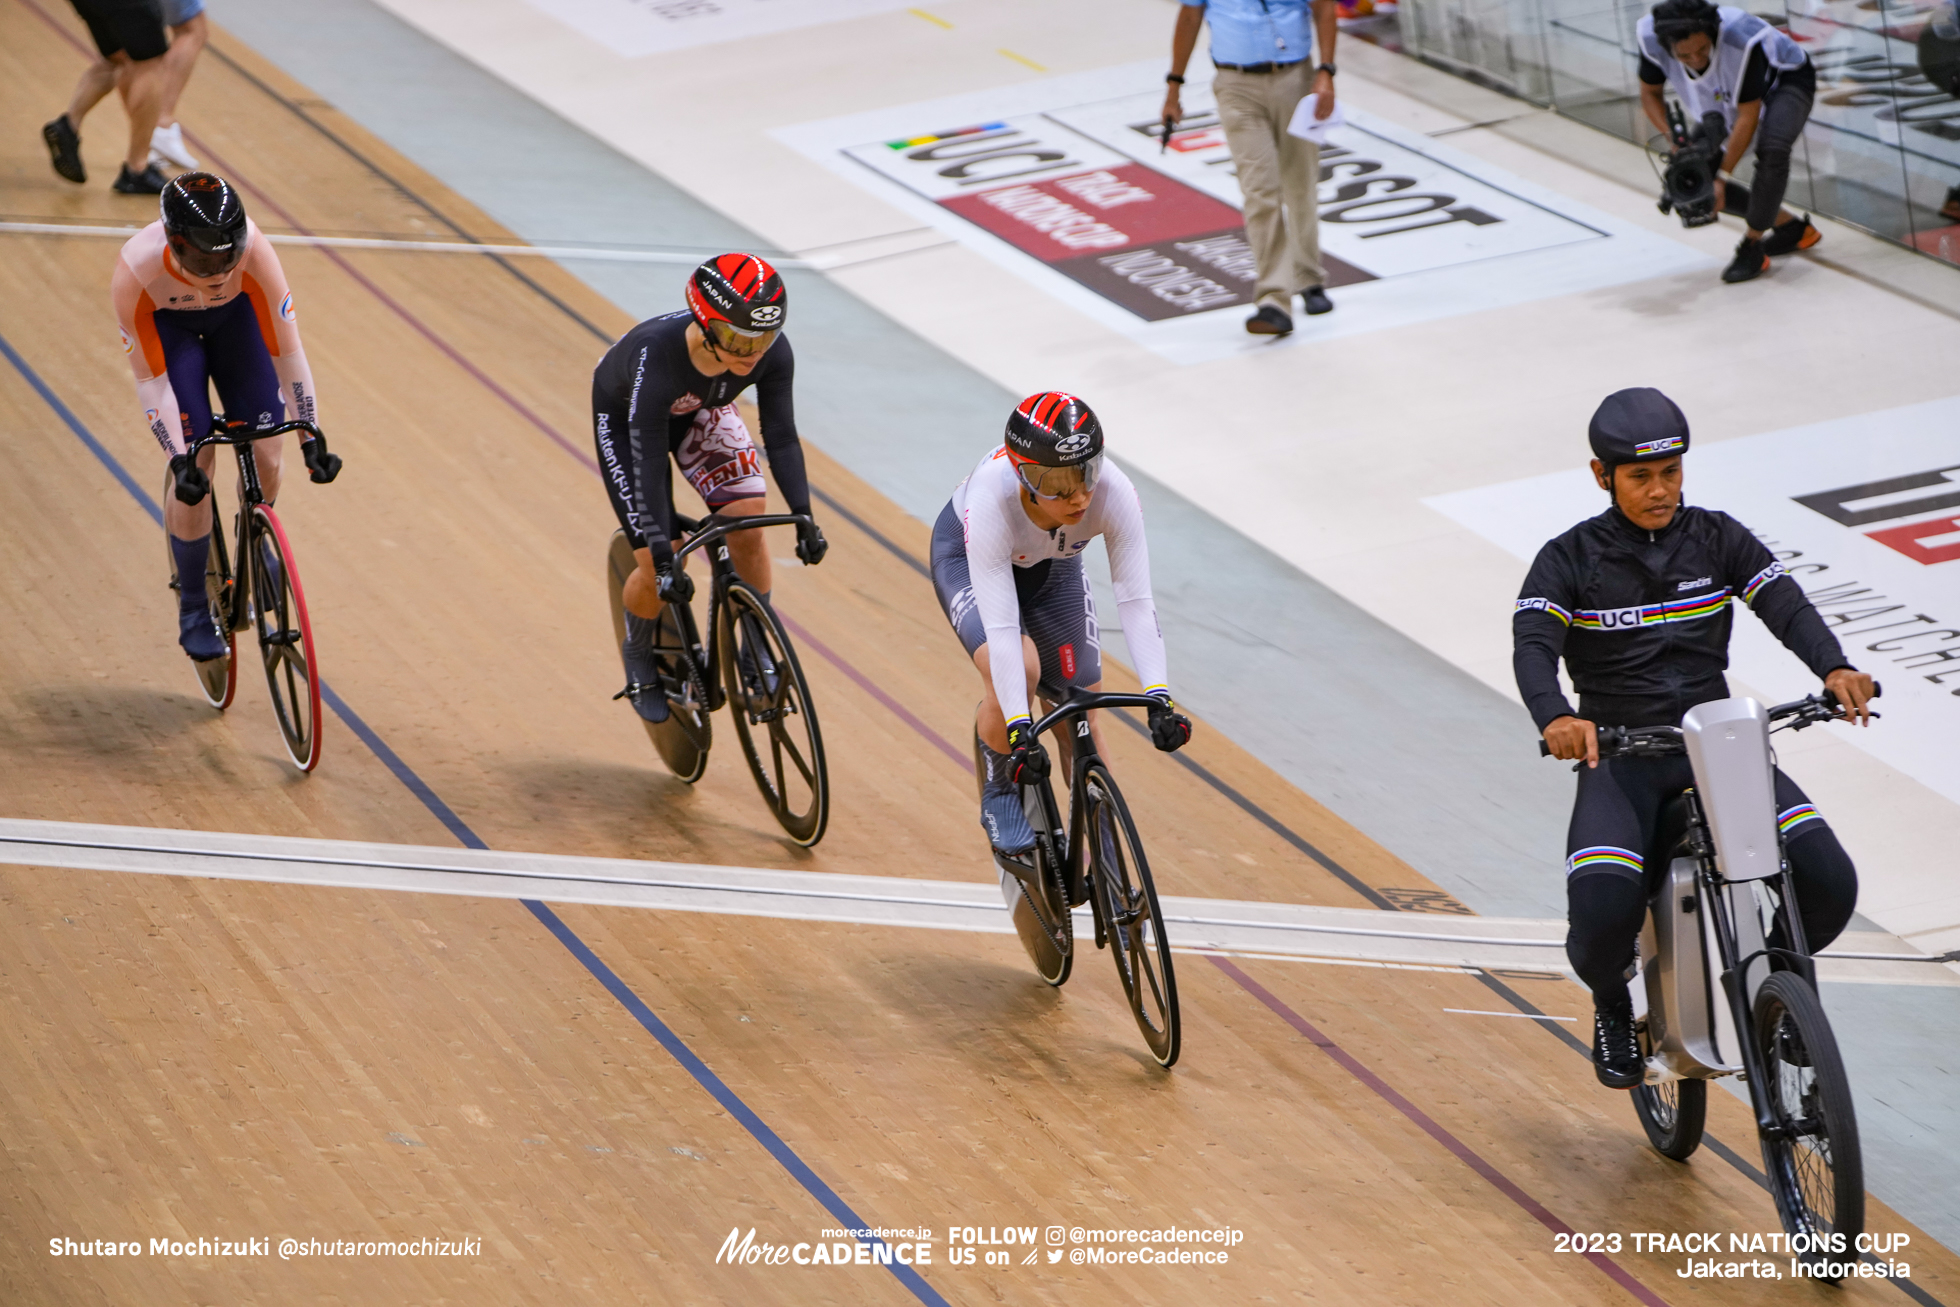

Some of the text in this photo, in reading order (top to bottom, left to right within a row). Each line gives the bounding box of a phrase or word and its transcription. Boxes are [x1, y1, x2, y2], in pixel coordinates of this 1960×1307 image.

[907, 131, 1082, 187] UCI
[1054, 170, 1155, 209] TRACK
[977, 184, 1130, 249] NATIONS CUP
[702, 280, 733, 310] JAPAN
[1096, 248, 1239, 312] INDONESIA
[292, 381, 304, 422] EDERLANDSE
[154, 418, 178, 456] NEDERLANDS
[1006, 429, 1032, 449] APAN
[1058, 447, 1094, 462] Kabuto
[1651, 439, 1672, 451] UCI
[1677, 575, 1713, 592] Santini
[1601, 610, 1641, 629] UCI
[1804, 581, 1960, 698] WATCH
